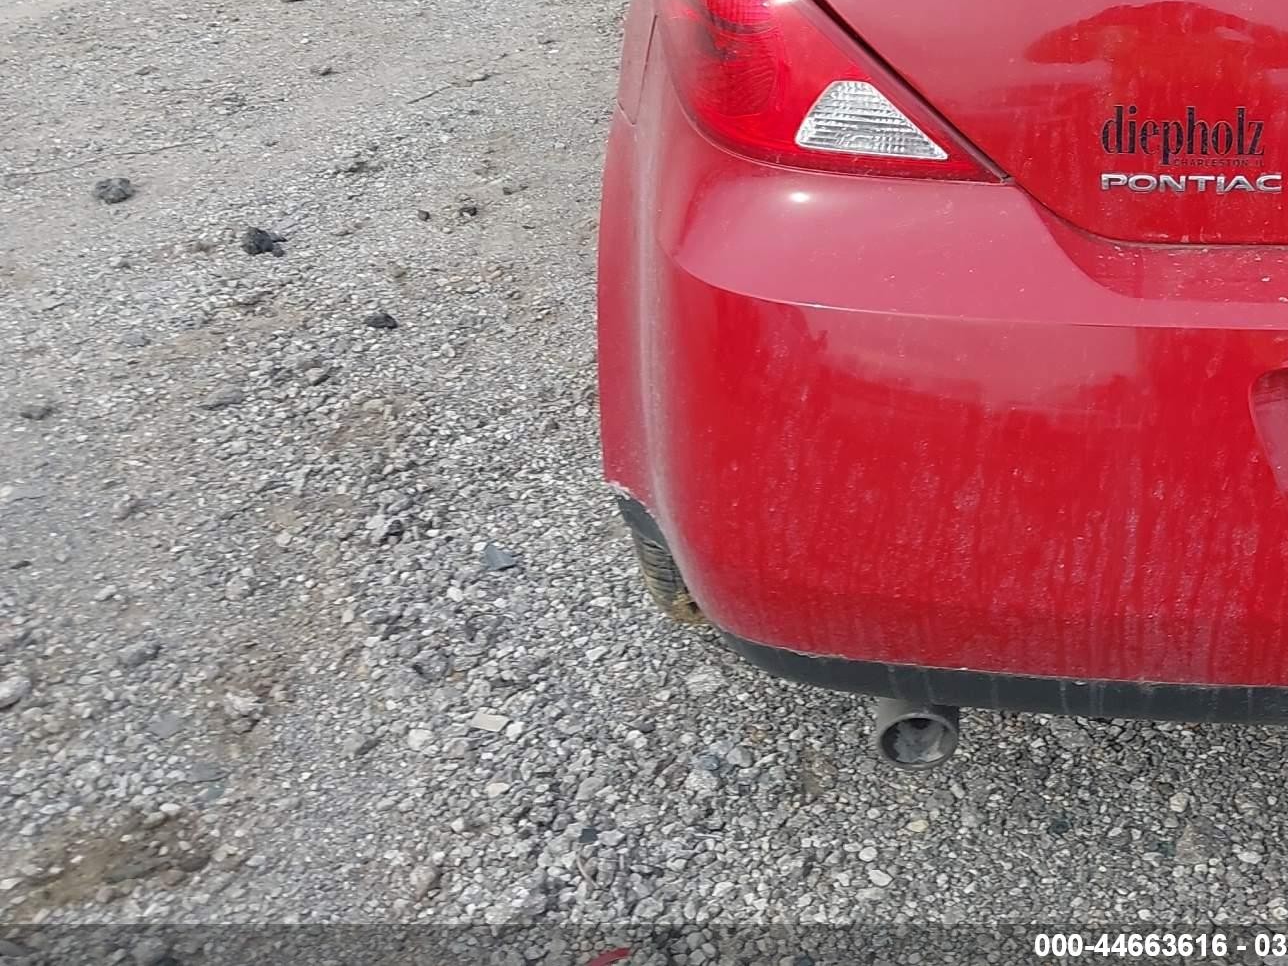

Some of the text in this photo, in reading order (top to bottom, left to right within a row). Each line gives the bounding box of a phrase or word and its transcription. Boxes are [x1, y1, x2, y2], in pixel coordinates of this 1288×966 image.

[1101, 105, 1265, 166] diepholz
[1174, 158, 1249, 167] CHARLESTON
[1101, 173, 1281, 193] PONTIAC
